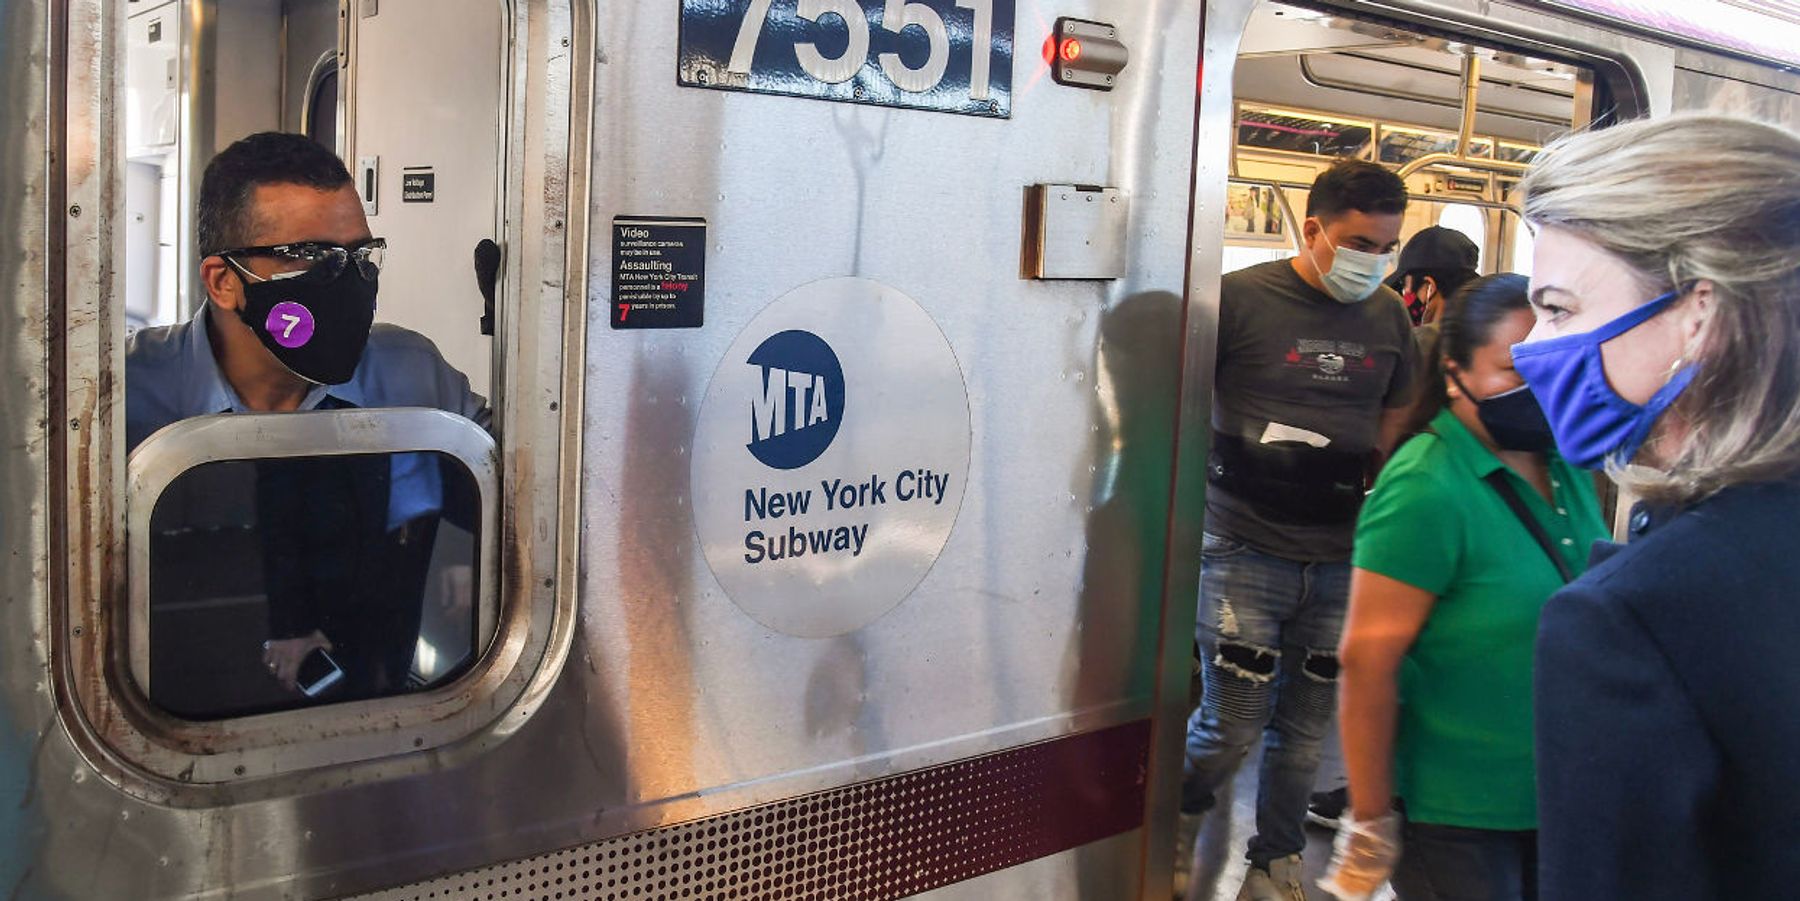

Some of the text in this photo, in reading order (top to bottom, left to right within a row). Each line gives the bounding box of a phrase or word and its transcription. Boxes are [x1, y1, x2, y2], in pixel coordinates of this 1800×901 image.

[620, 226, 649, 238] Video
[620, 260, 673, 273] Assaulting
[618, 283, 650, 291] personnel
[661, 281, 689, 292] felony
[620, 273, 699, 282] MTA New York City Transit
[618, 303, 630, 322] 7
[631, 303, 649, 311] years
[281, 313, 301, 338] 7
[749, 364, 829, 442] MTA
[744, 468, 950, 521] New York City
[744, 523, 869, 564] Subway
